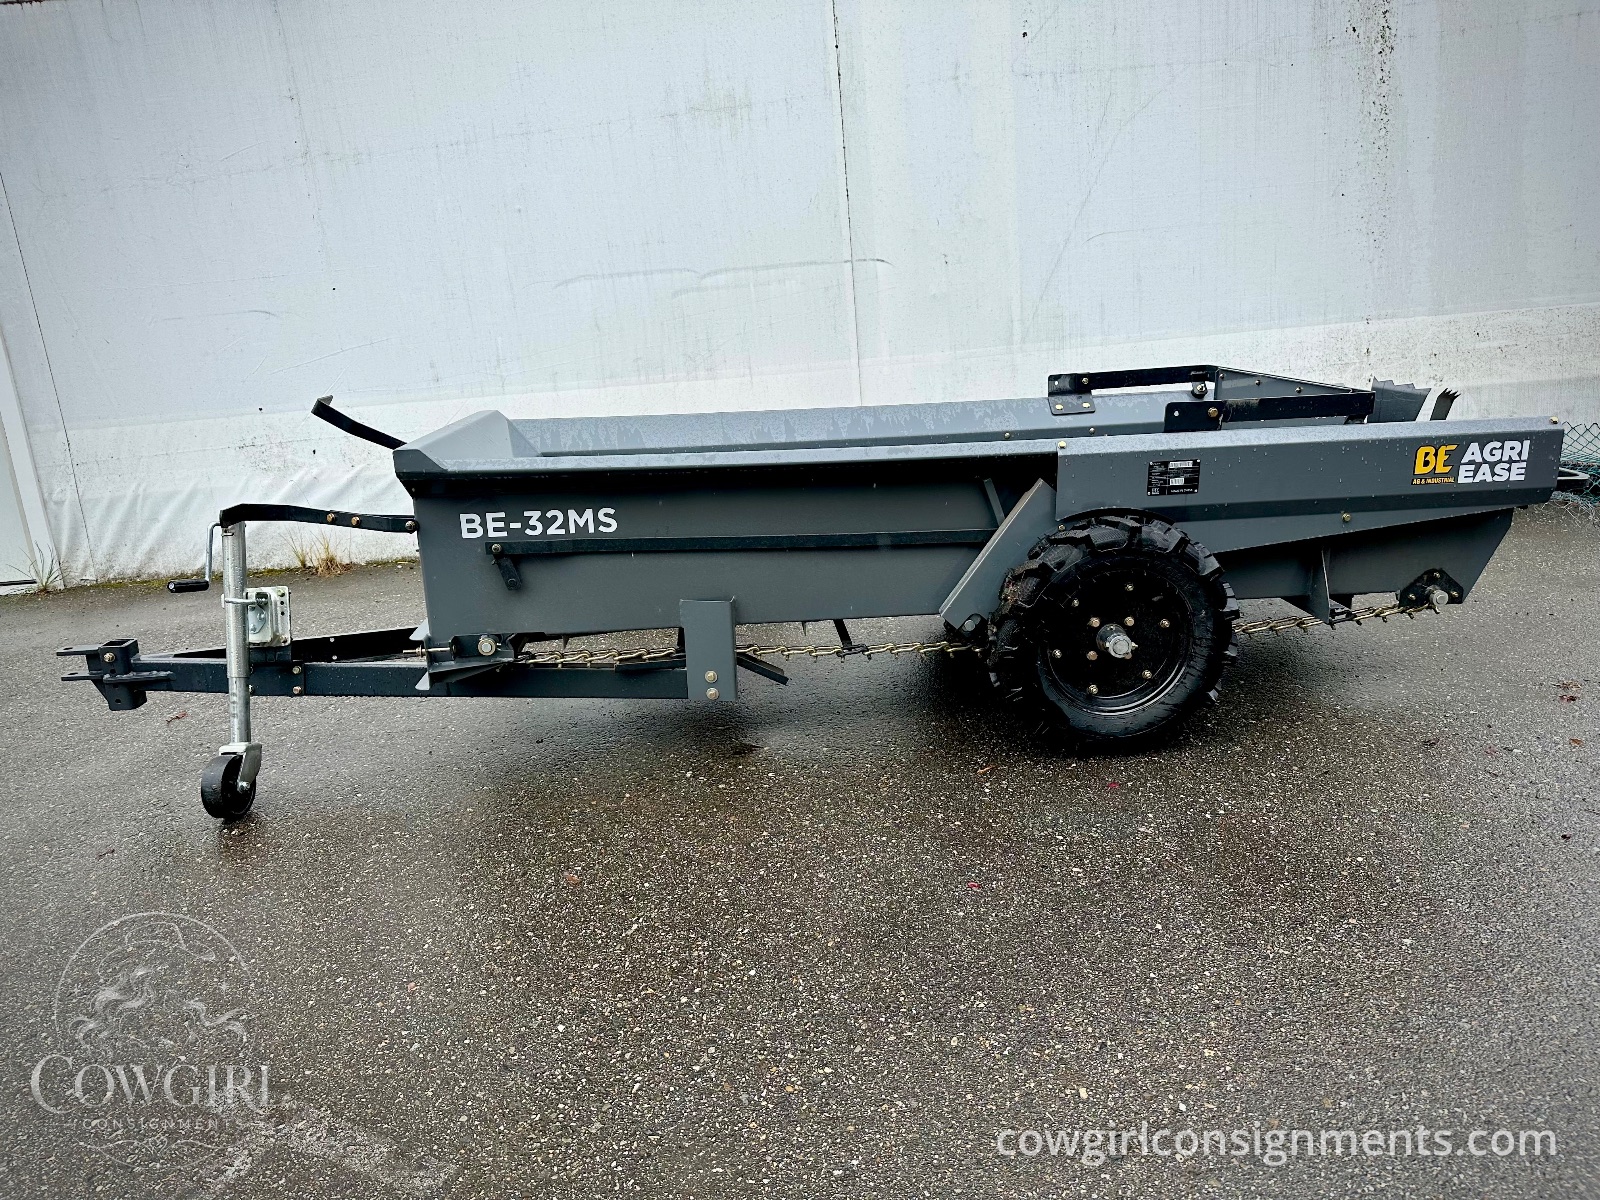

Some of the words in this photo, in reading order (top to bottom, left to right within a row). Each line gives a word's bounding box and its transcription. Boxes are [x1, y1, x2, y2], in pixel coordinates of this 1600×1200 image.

[1414, 444, 1458, 475] BE
[1461, 440, 1530, 463] AGRI
[1458, 462, 1527, 484] EASE
[459, 507, 618, 539] BE-32MS
